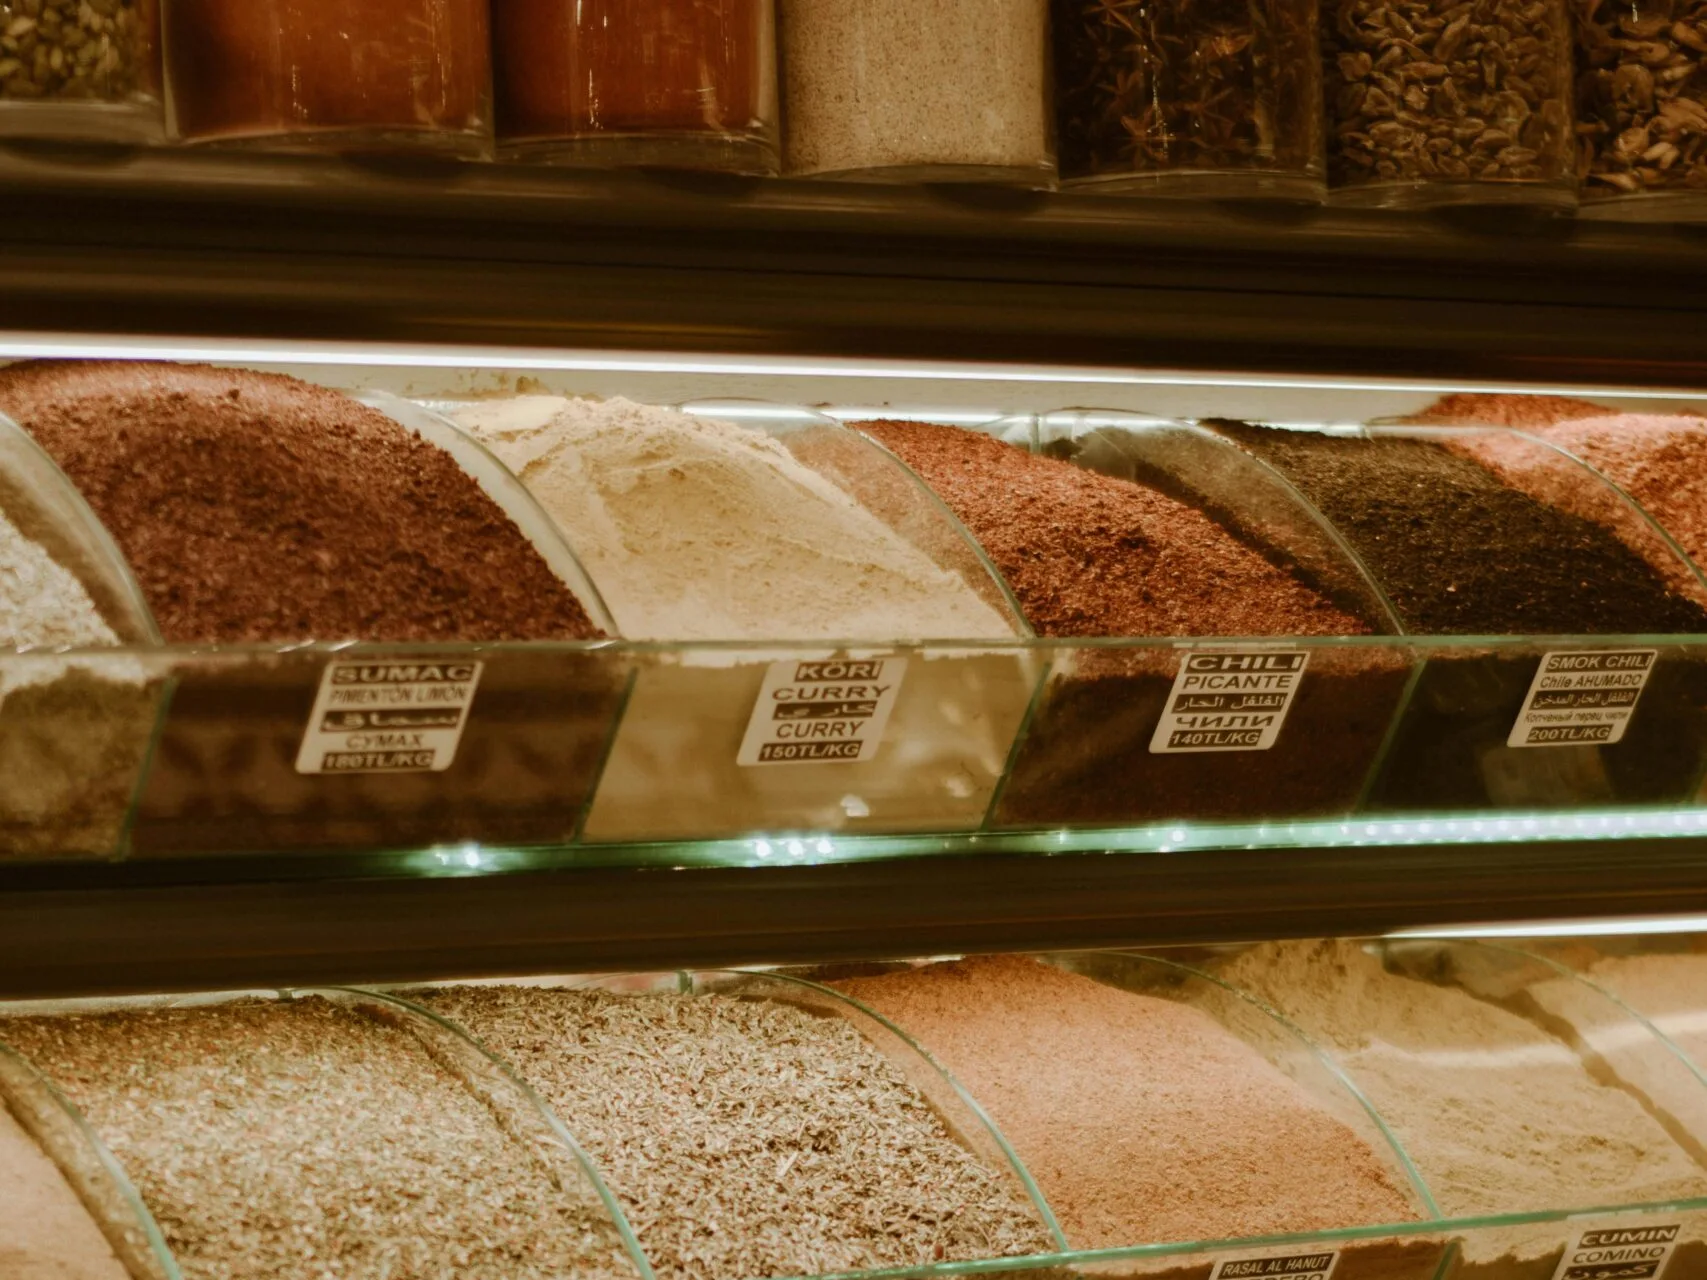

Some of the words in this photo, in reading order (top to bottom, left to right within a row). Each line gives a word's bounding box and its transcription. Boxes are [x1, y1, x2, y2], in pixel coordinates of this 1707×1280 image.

[1189, 656, 1303, 670] CHILI
[1547, 656, 1600, 669] SMOK
[1606, 655, 1652, 668] CHILI
[333, 666, 473, 682] SUMAC
[1540, 676, 1573, 688] Chile
[1575, 674, 1642, 687] AHUMADO
[1182, 675, 1293, 689] PICANTE
[772, 685, 890, 700] CURRY
[1177, 696, 1224, 710] الحار
[1231, 696, 1284, 709] الفلفل
[1176, 715, 1275, 728] ЧИЛИ
[776, 721, 864, 738] CURRY
[1529, 727, 1610, 741] 200TL/KG
[1172, 732, 1260, 744] 140TL/KG
[762, 744, 860, 759] 150TL/KG
[1581, 1229, 1676, 1245] CUMIN
[1573, 1247, 1665, 1264] COMINO
[1222, 1262, 1263, 1276] RASAL
[1266, 1260, 1282, 1272] AL
[1285, 1256, 1329, 1271] HANUT
